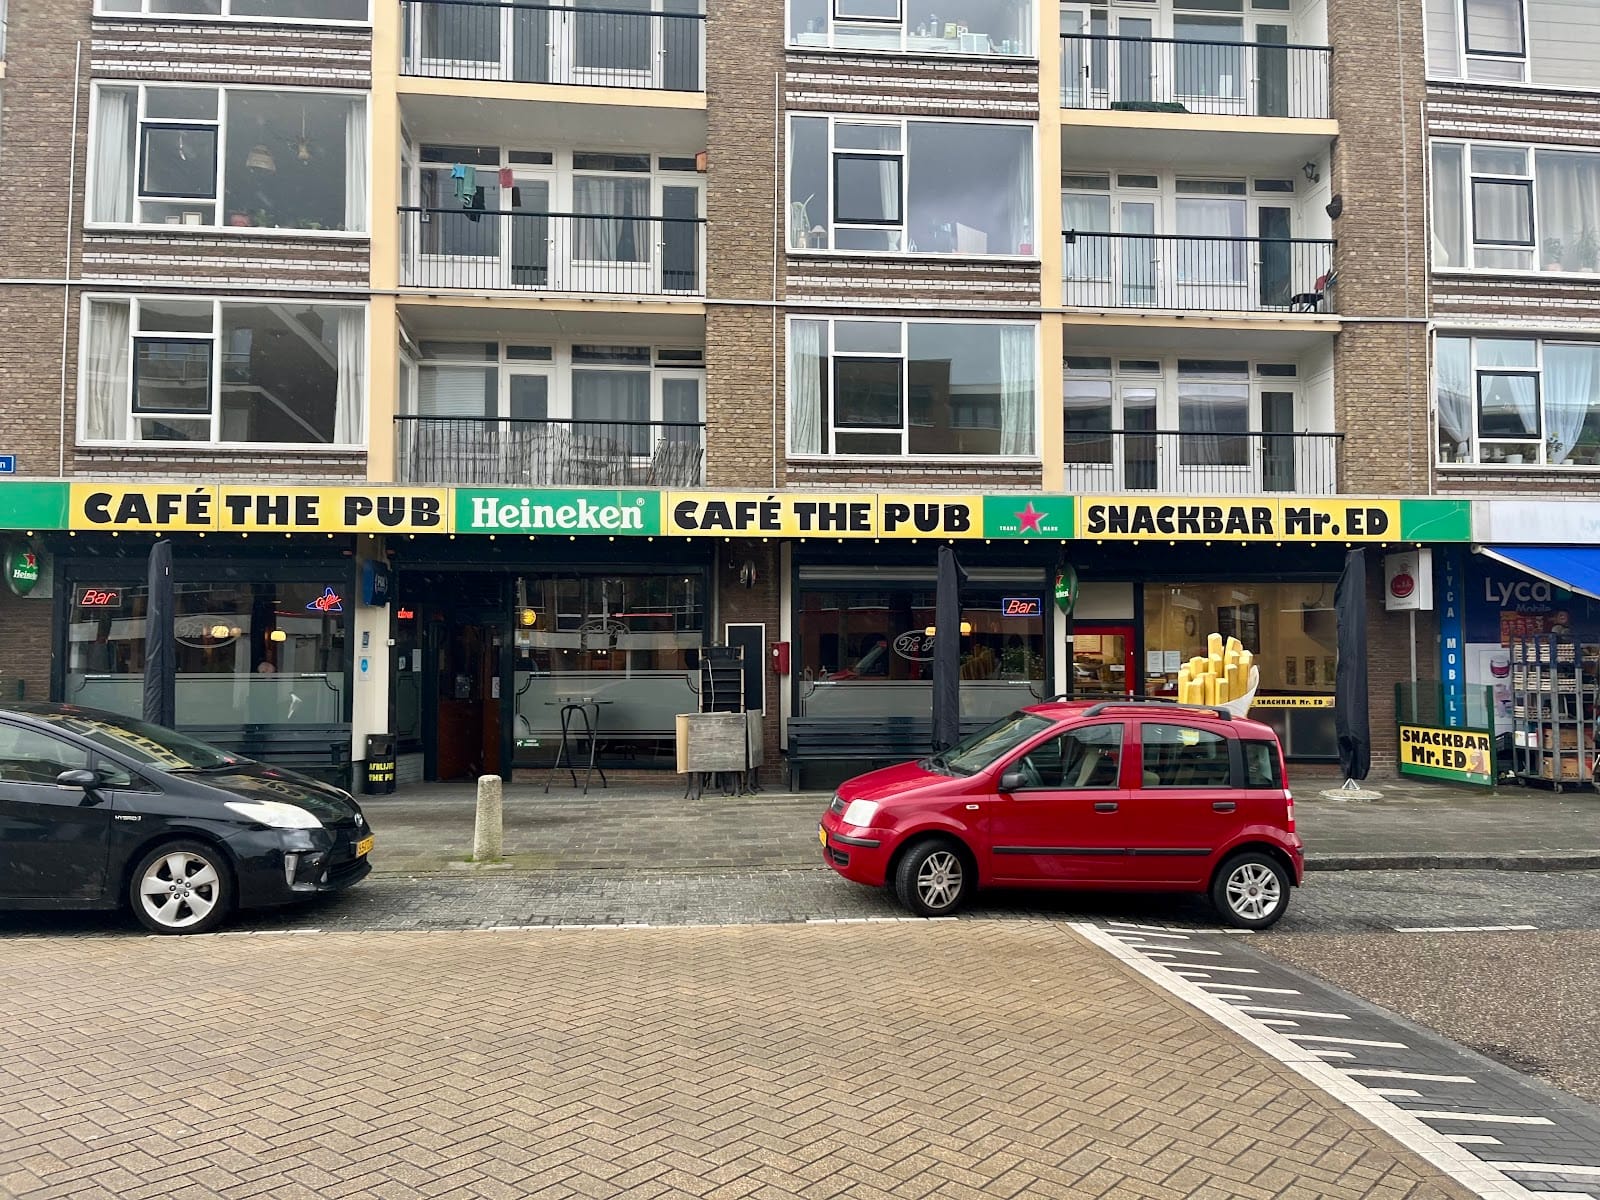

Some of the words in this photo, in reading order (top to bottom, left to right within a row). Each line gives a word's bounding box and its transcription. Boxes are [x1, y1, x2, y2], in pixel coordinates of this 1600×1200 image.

[84, 487, 211, 525] CAFÉ
[225, 495, 320, 526] THE
[344, 496, 442, 528] PUB
[673, 496, 781, 531] CAFÉ
[793, 502, 871, 532] THE
[884, 503, 971, 533] PUB
[1087, 505, 1274, 535] SNACKBAR
[81, 589, 117, 605] Bar
[1485, 576, 1552, 606] Lyca
[1006, 600, 1037, 614] Bar
[1446, 638, 1458, 727] MOBILE
[1402, 729, 1490, 751] SNACKBAR
[368, 773, 384, 782] THE
